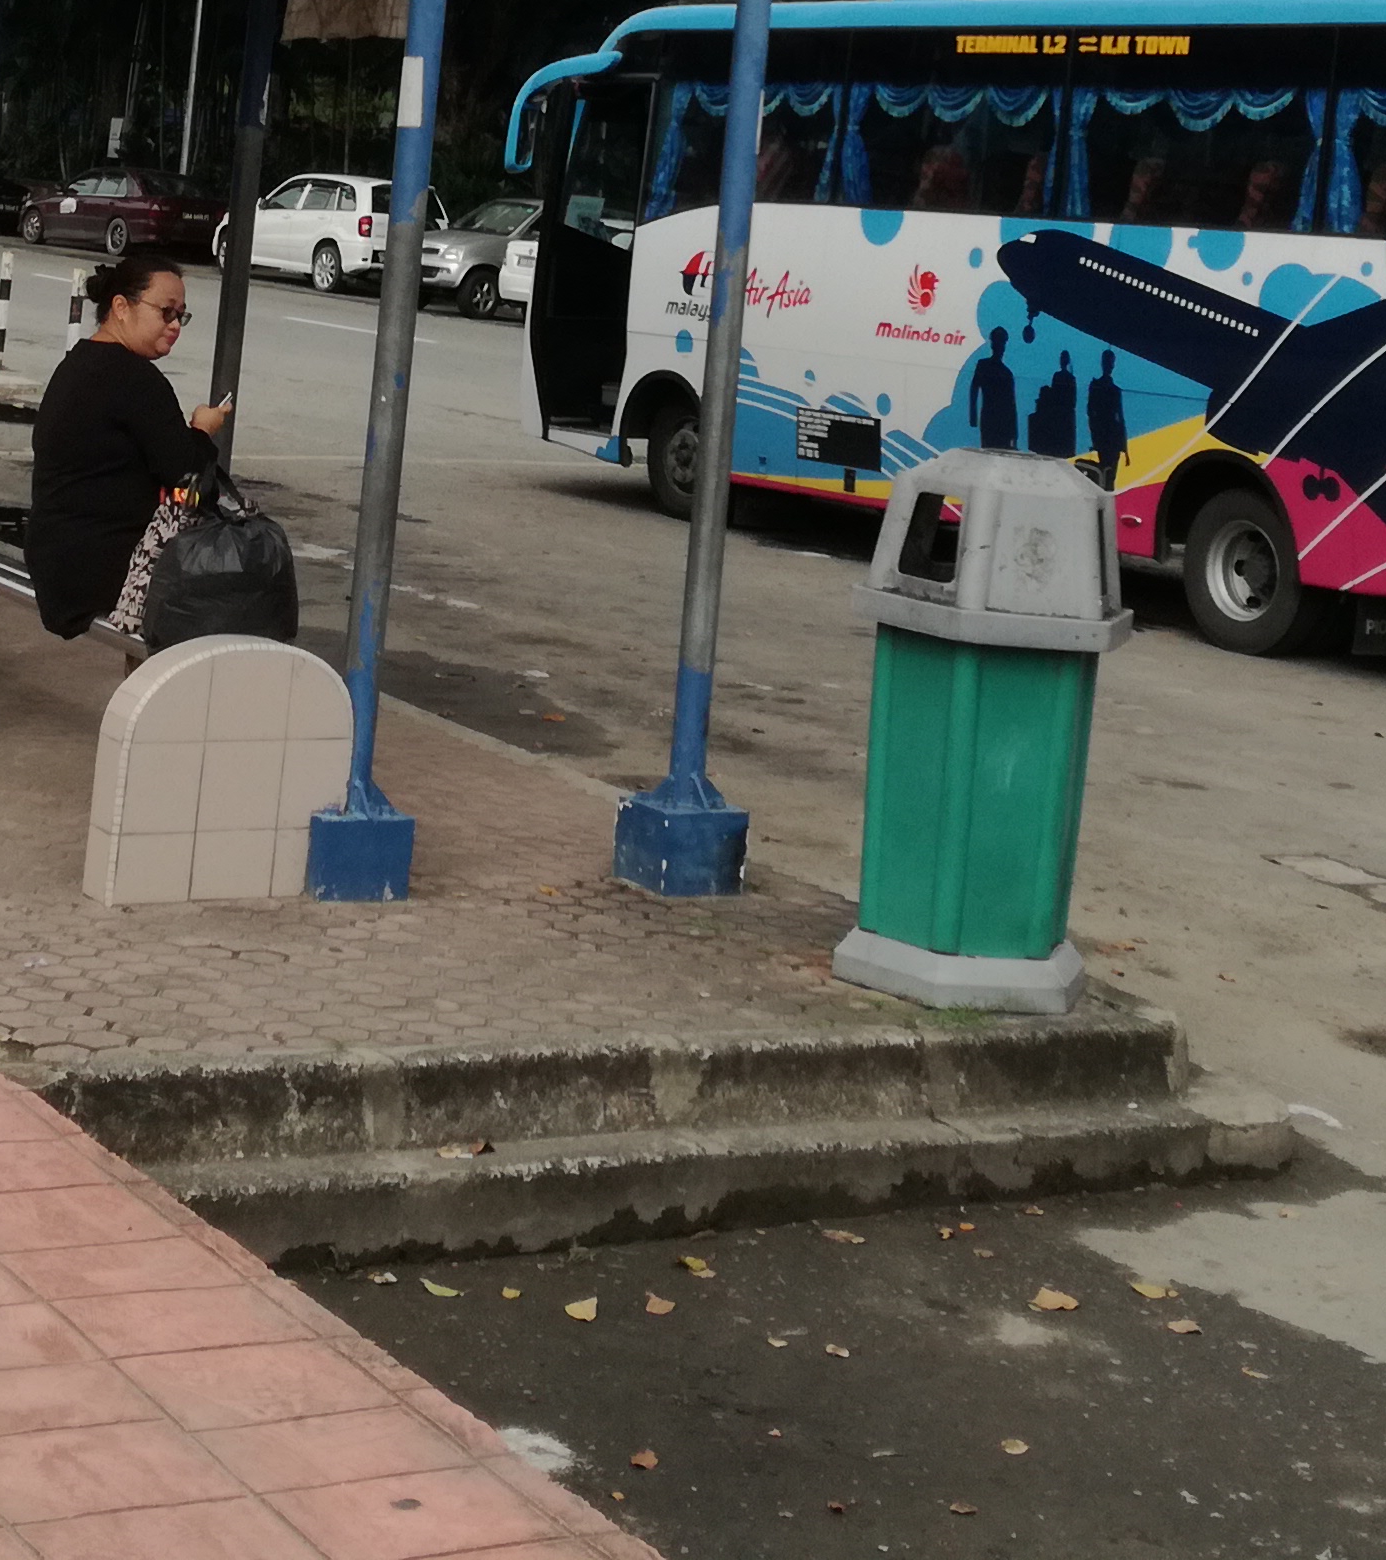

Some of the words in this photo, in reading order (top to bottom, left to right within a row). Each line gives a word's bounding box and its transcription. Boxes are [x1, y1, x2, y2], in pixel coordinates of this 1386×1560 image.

[956, 35, 1038, 54] TERMINAL
[1134, 35, 1191, 56] TOWN
[943, 329, 965, 346] air
